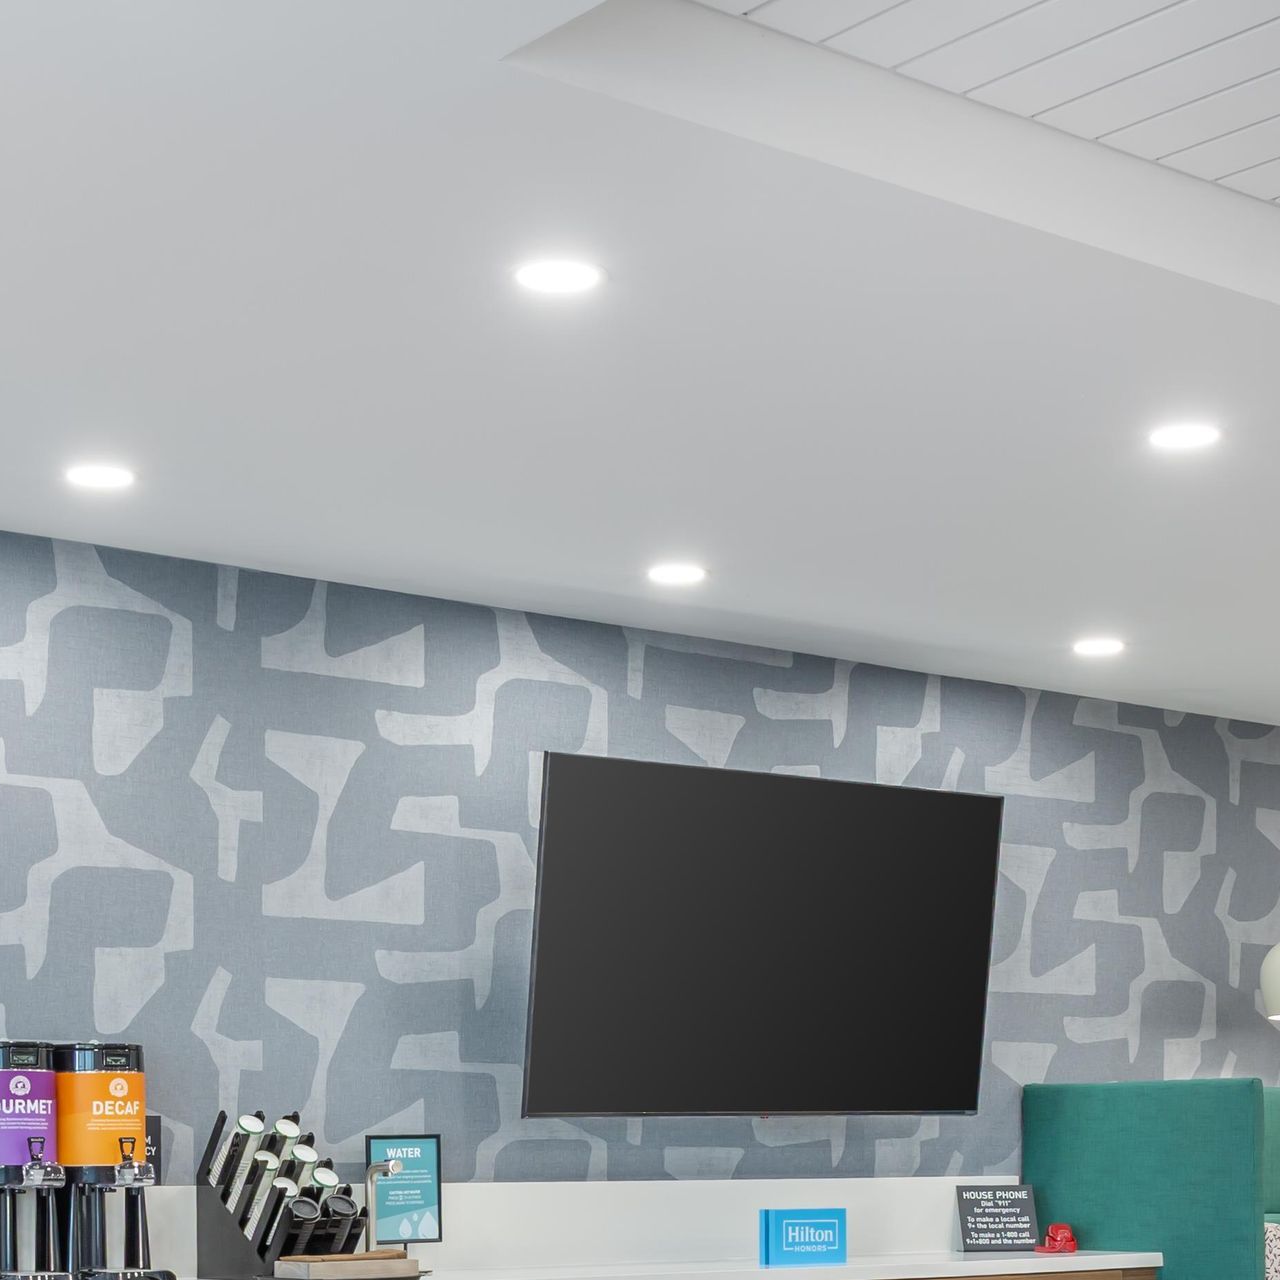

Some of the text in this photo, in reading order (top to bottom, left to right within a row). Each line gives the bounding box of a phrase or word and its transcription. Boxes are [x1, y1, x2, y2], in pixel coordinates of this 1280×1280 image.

[92, 1101, 140, 1115] DECAF
[386, 1148, 421, 1158] WATER
[962, 1190, 1028, 1199] HOUSE PHONE
[788, 1226, 833, 1242] Hilton
